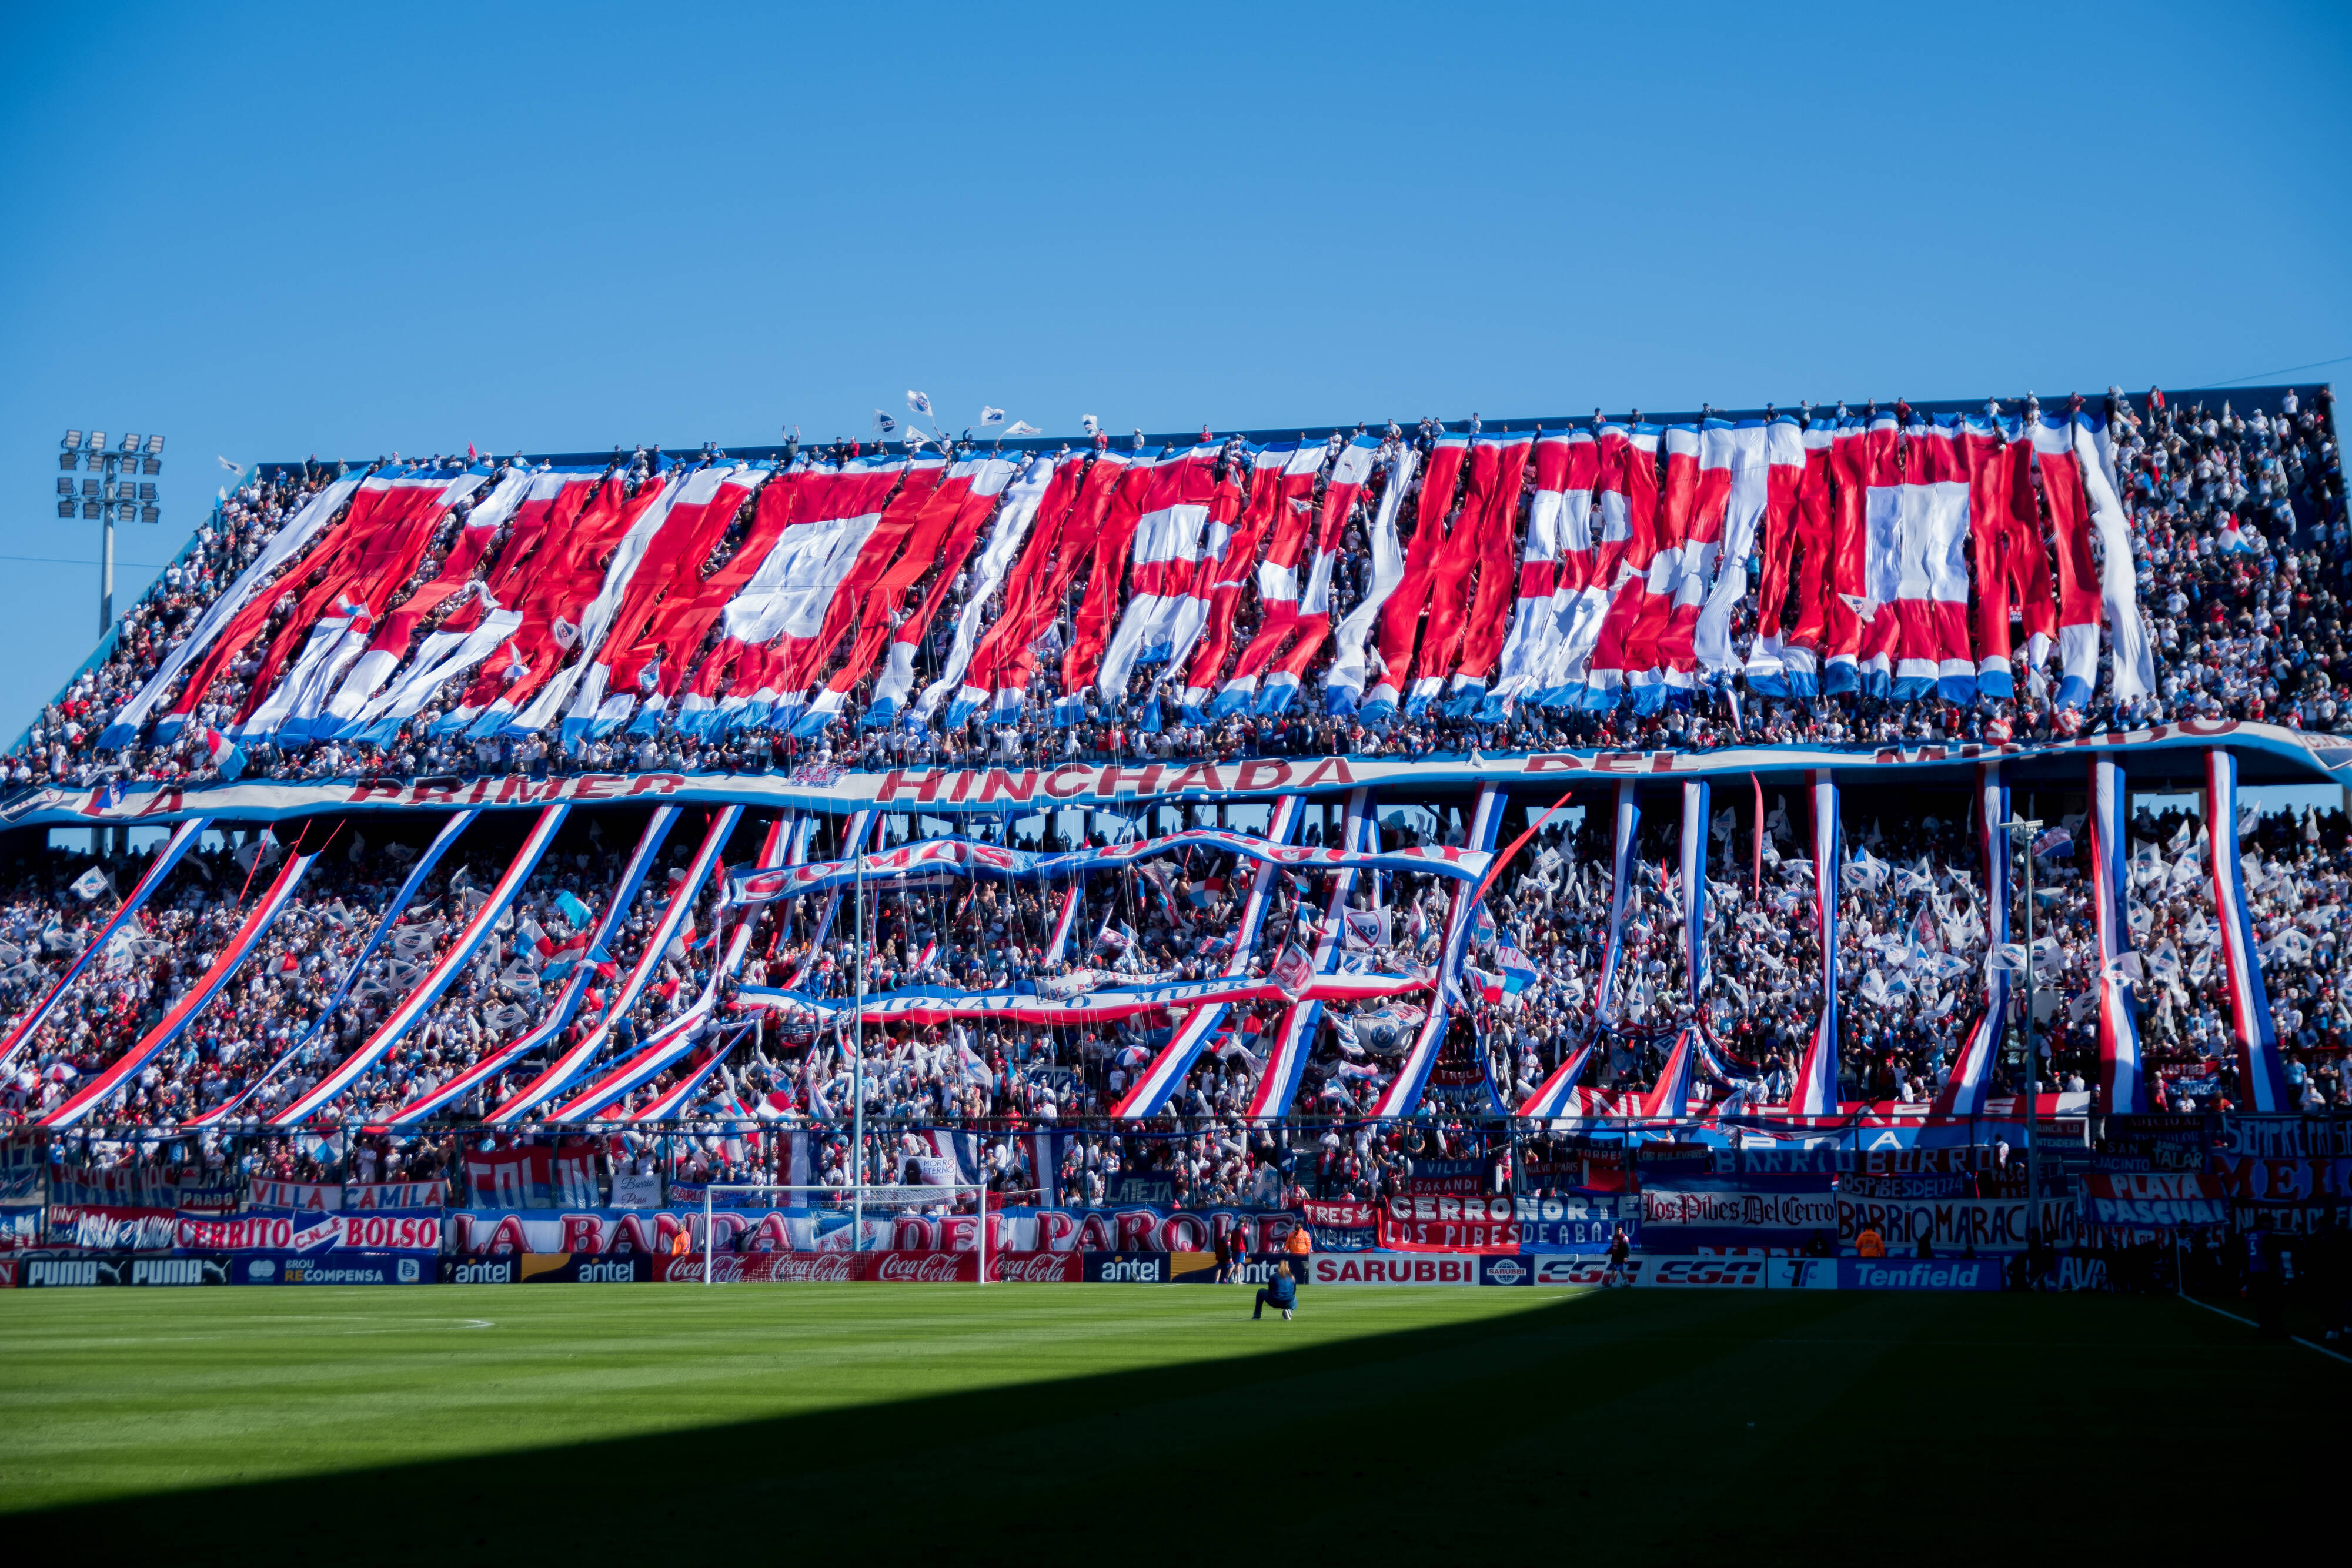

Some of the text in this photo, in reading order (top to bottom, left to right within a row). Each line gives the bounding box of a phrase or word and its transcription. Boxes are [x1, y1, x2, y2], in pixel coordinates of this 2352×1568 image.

[343, 773, 686, 807] PRIMER
[874, 757, 1357, 805] HINCHADA
[1521, 750, 1693, 774] DEL
[1576, 1148, 1622, 1160] TORRES
[2107, 1142, 2139, 1154] SAN
[2152, 1148, 2204, 1169] TALAR
[1426, 1162, 1472, 1174] VILLA
[1554, 1160, 1579, 1173] PARIS
[1866, 1148, 1993, 1174] BORRO
[2094, 1156, 2150, 1172] JACINTO
[252, 1181, 442, 1210] VILLA CAMILA
[620, 1176, 656, 1191] Barrio
[1105, 1178, 1175, 1202] LA TEJA
[1415, 1178, 1478, 1192] SARANDI
[2110, 1175, 2204, 1199] PLAYA
[182, 1191, 233, 1207] PRADO
[1389, 1194, 1641, 1221] CERRO NORTE
[1642, 1192, 1836, 1226] Los Pibes Del Cerro
[1304, 1204, 1354, 1223] TRES
[1935, 1202, 2076, 1245] MARACNA
[176, 1216, 292, 1249] CERRITO
[345, 1216, 437, 1248] BOLSO
[453, 1212, 536, 1254] LA
[559, 1211, 795, 1254] BANDA
[890, 1212, 1014, 1252] DEL
[1385, 1221, 1428, 1245] LOS
[1444, 1224, 1521, 1247] PIBES
[1522, 1222, 1551, 1243] DE
[28, 1260, 98, 1285] PUMA
[132, 1259, 203, 1285] PUMA
[285, 1259, 315, 1269] BROU
[285, 1268, 385, 1283] RECOMPENSA
[455, 1259, 511, 1283] antel
[579, 1258, 634, 1283] antel
[879, 1252, 963, 1282] Coca-Cola
[1101, 1257, 1160, 1281] antel
[1316, 1259, 1472, 1283] SARUBBI
[1855, 1262, 1980, 1288] Tenfield
